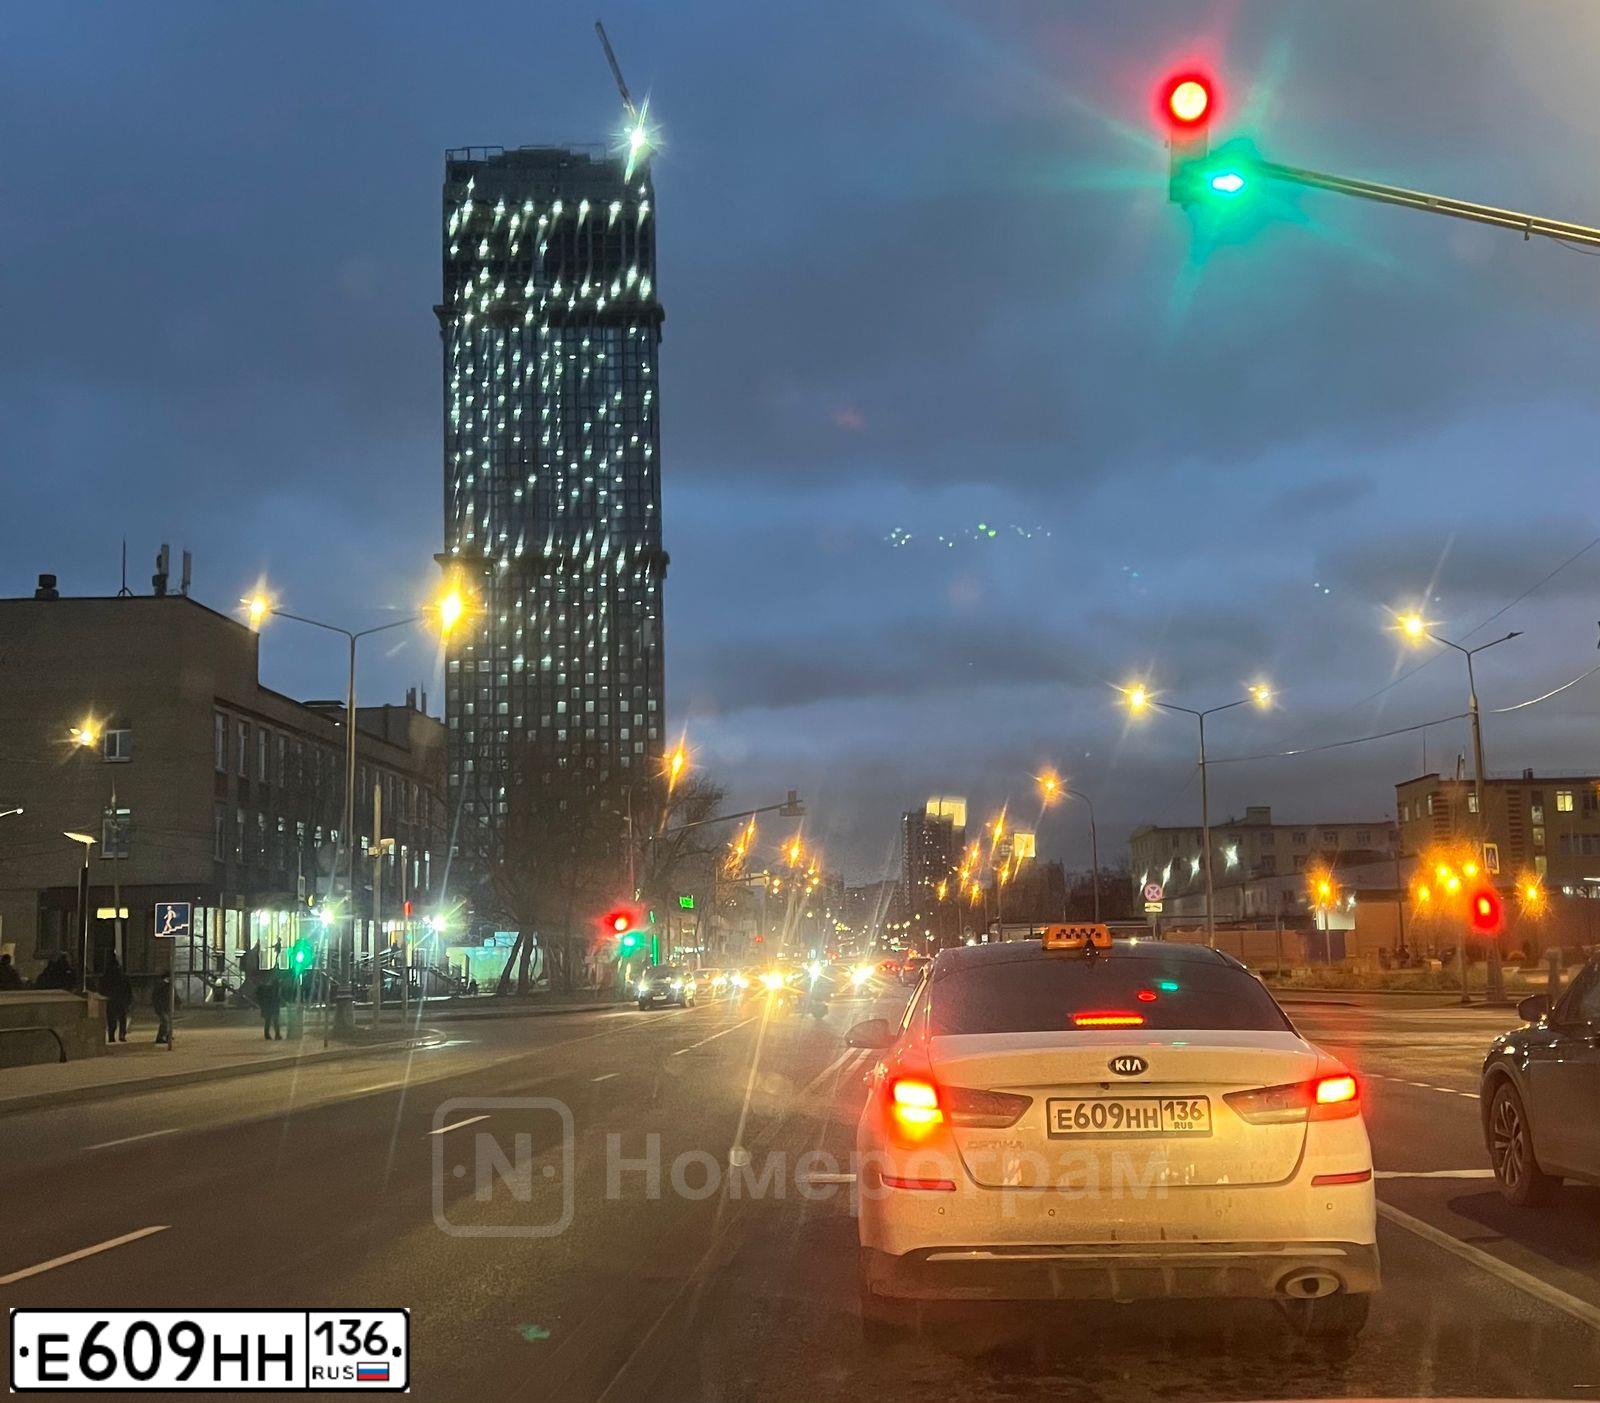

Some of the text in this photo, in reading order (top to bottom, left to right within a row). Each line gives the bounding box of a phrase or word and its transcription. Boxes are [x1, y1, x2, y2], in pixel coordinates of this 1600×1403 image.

[1115, 1059, 1142, 1071] KIA
[1163, 1101, 1202, 1121] 136
[1174, 1122, 1194, 1130] RUS
